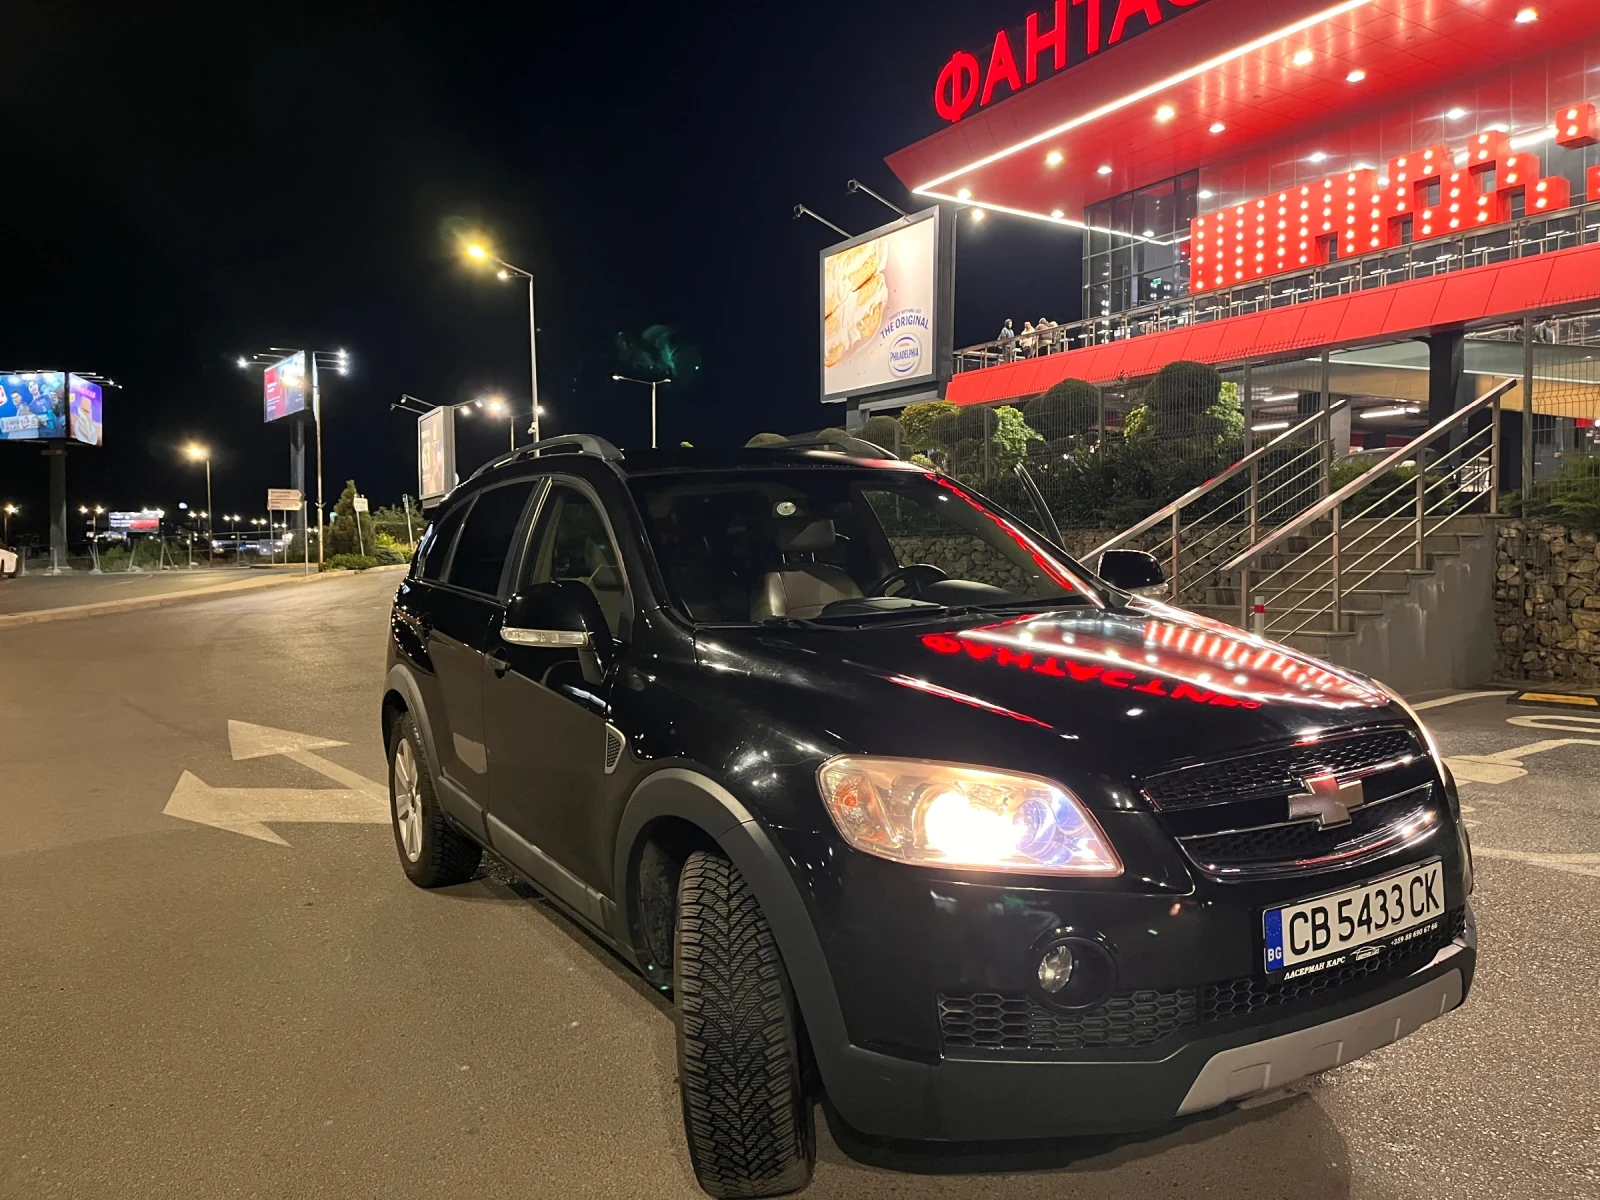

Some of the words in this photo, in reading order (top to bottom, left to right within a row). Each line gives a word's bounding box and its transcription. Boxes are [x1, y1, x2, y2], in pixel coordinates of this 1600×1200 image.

[934, 0, 1199, 123] ФАНТА
[880, 322, 894, 339] THE
[895, 315, 929, 330] ORIGINAL
[890, 347, 919, 362] PHILADELPHIA
[1338, 884, 1405, 943] 5433
[1390, 936, 1404, 946] +359
[1267, 946, 1283, 962] BG
